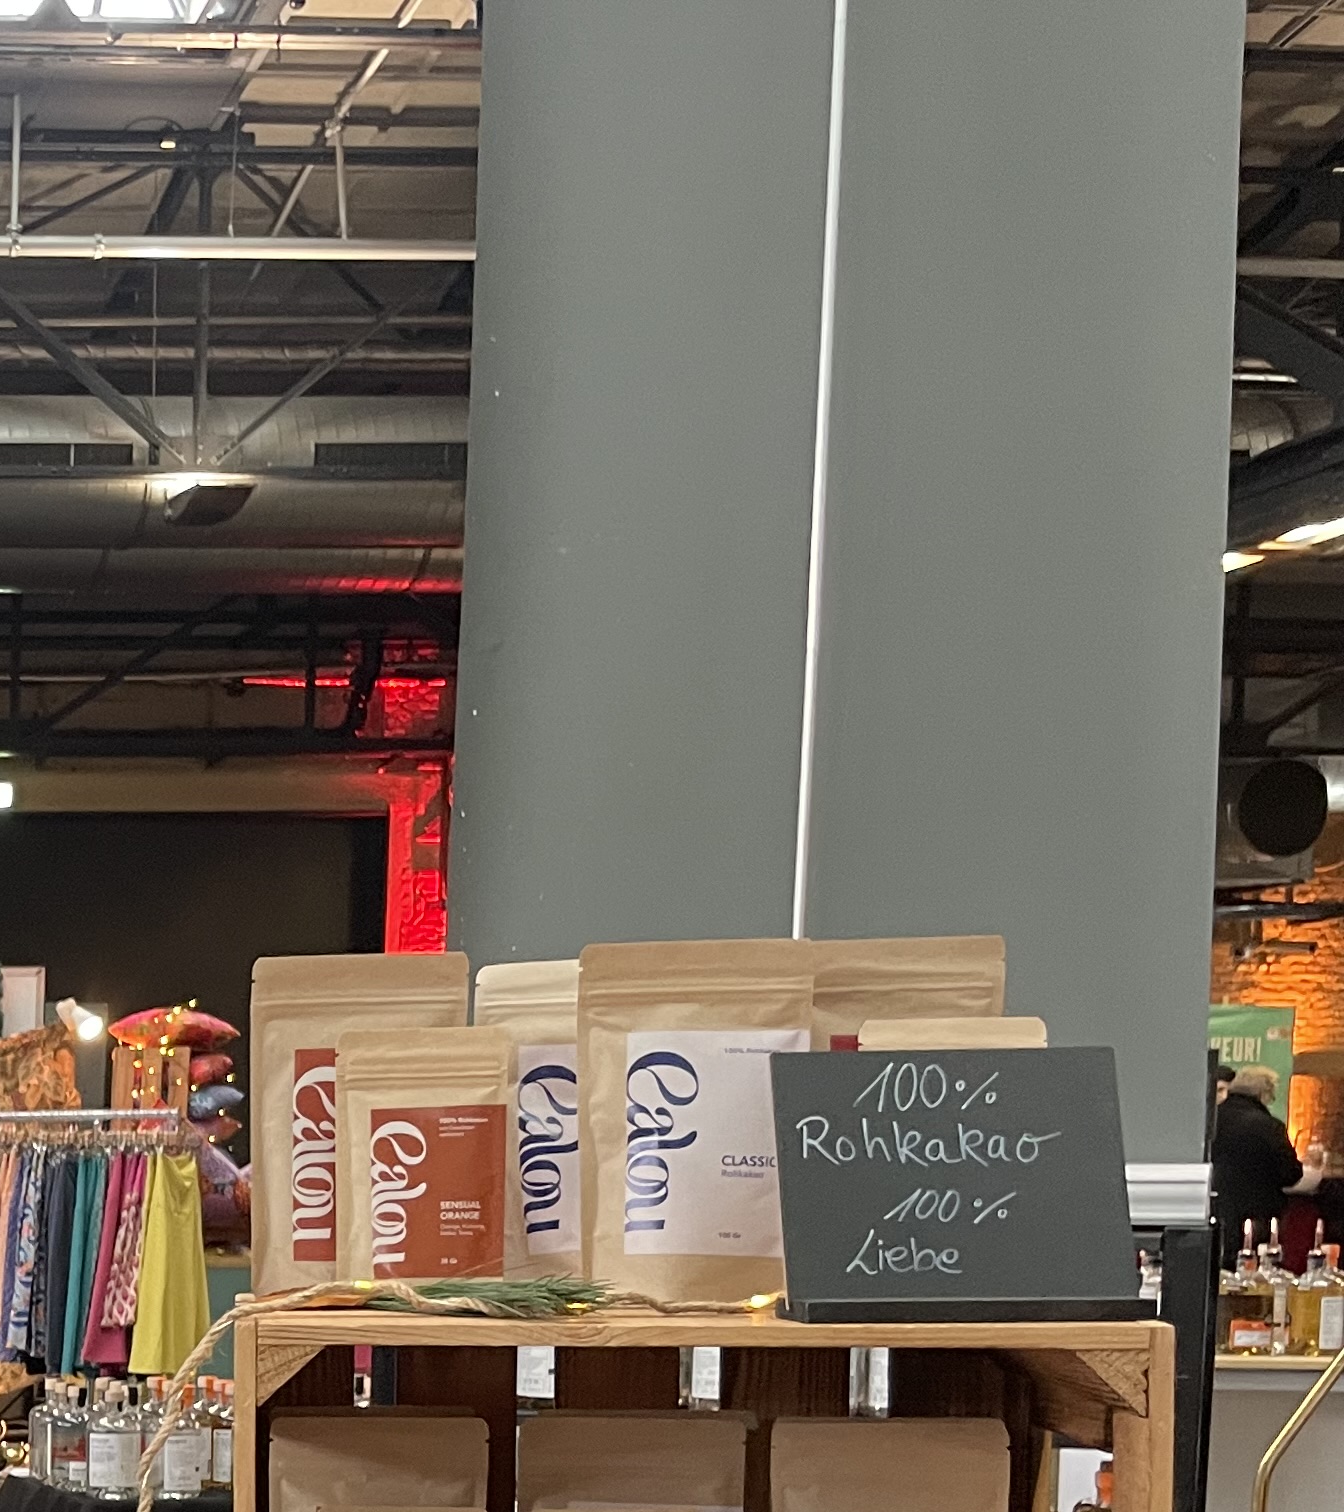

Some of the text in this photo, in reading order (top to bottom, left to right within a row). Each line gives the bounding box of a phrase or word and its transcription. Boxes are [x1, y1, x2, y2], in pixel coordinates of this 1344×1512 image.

[796, 1115, 1061, 1167] Rohkakao
[721, 1155, 777, 1168] CLASSIC
[440, 1201, 481, 1209] SENSUAL
[440, 1211, 480, 1220] ORANGE
[846, 1229, 963, 1275] Liebe
